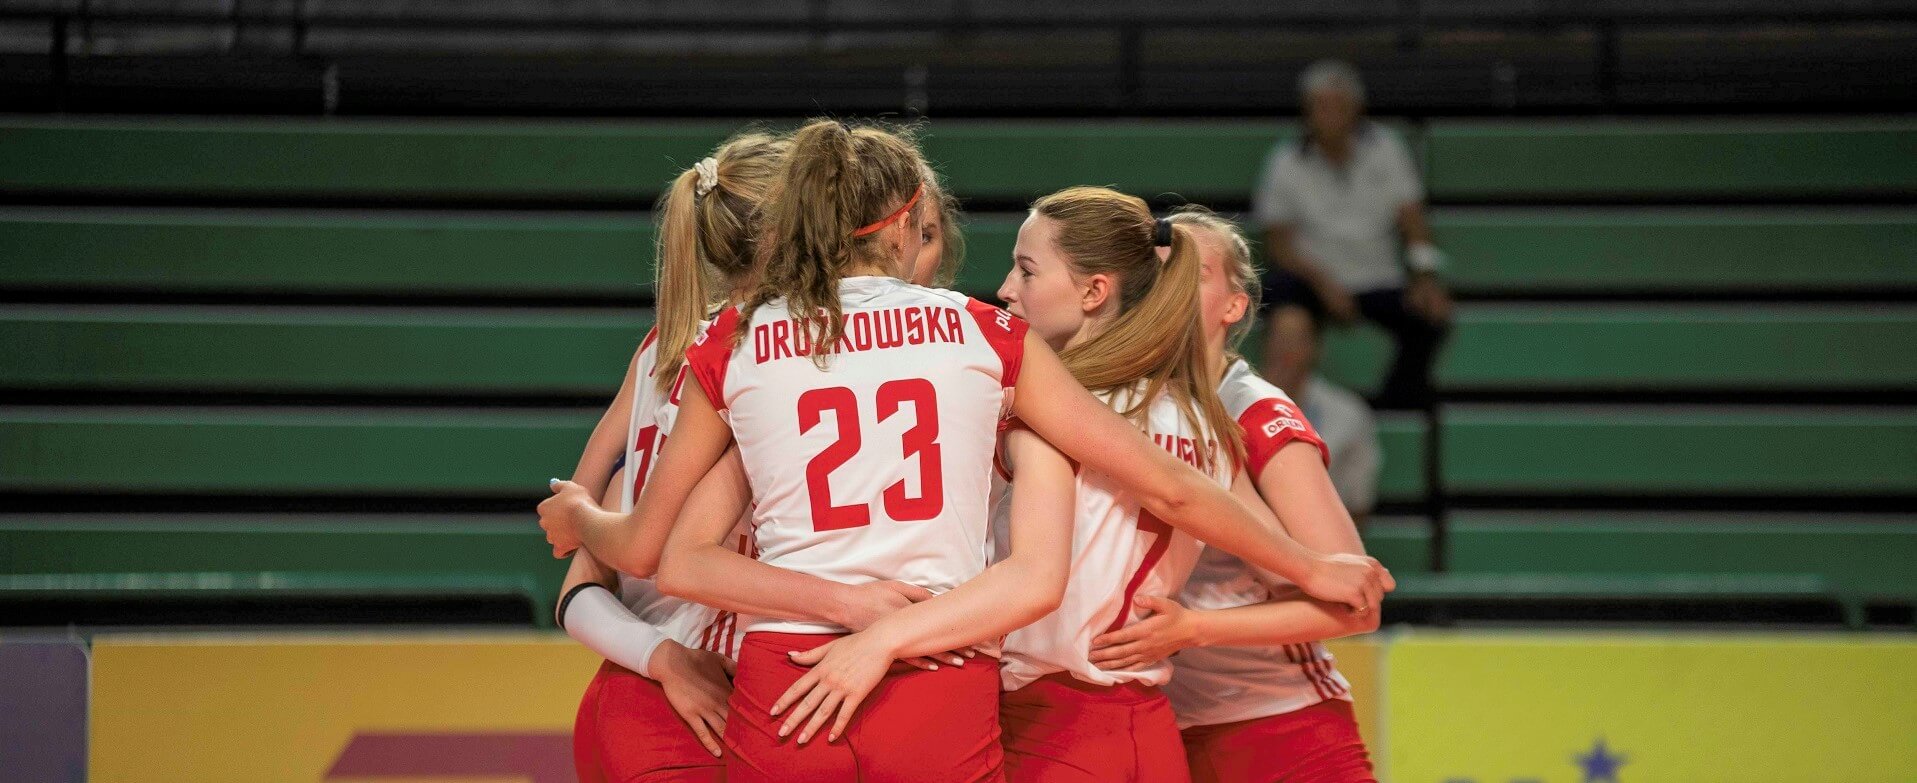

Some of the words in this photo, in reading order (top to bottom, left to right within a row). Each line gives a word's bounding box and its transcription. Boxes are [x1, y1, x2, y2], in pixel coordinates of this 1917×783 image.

[633, 424, 668, 506] 1
[797, 378, 944, 532] 23
[1104, 506, 1174, 634] 7
